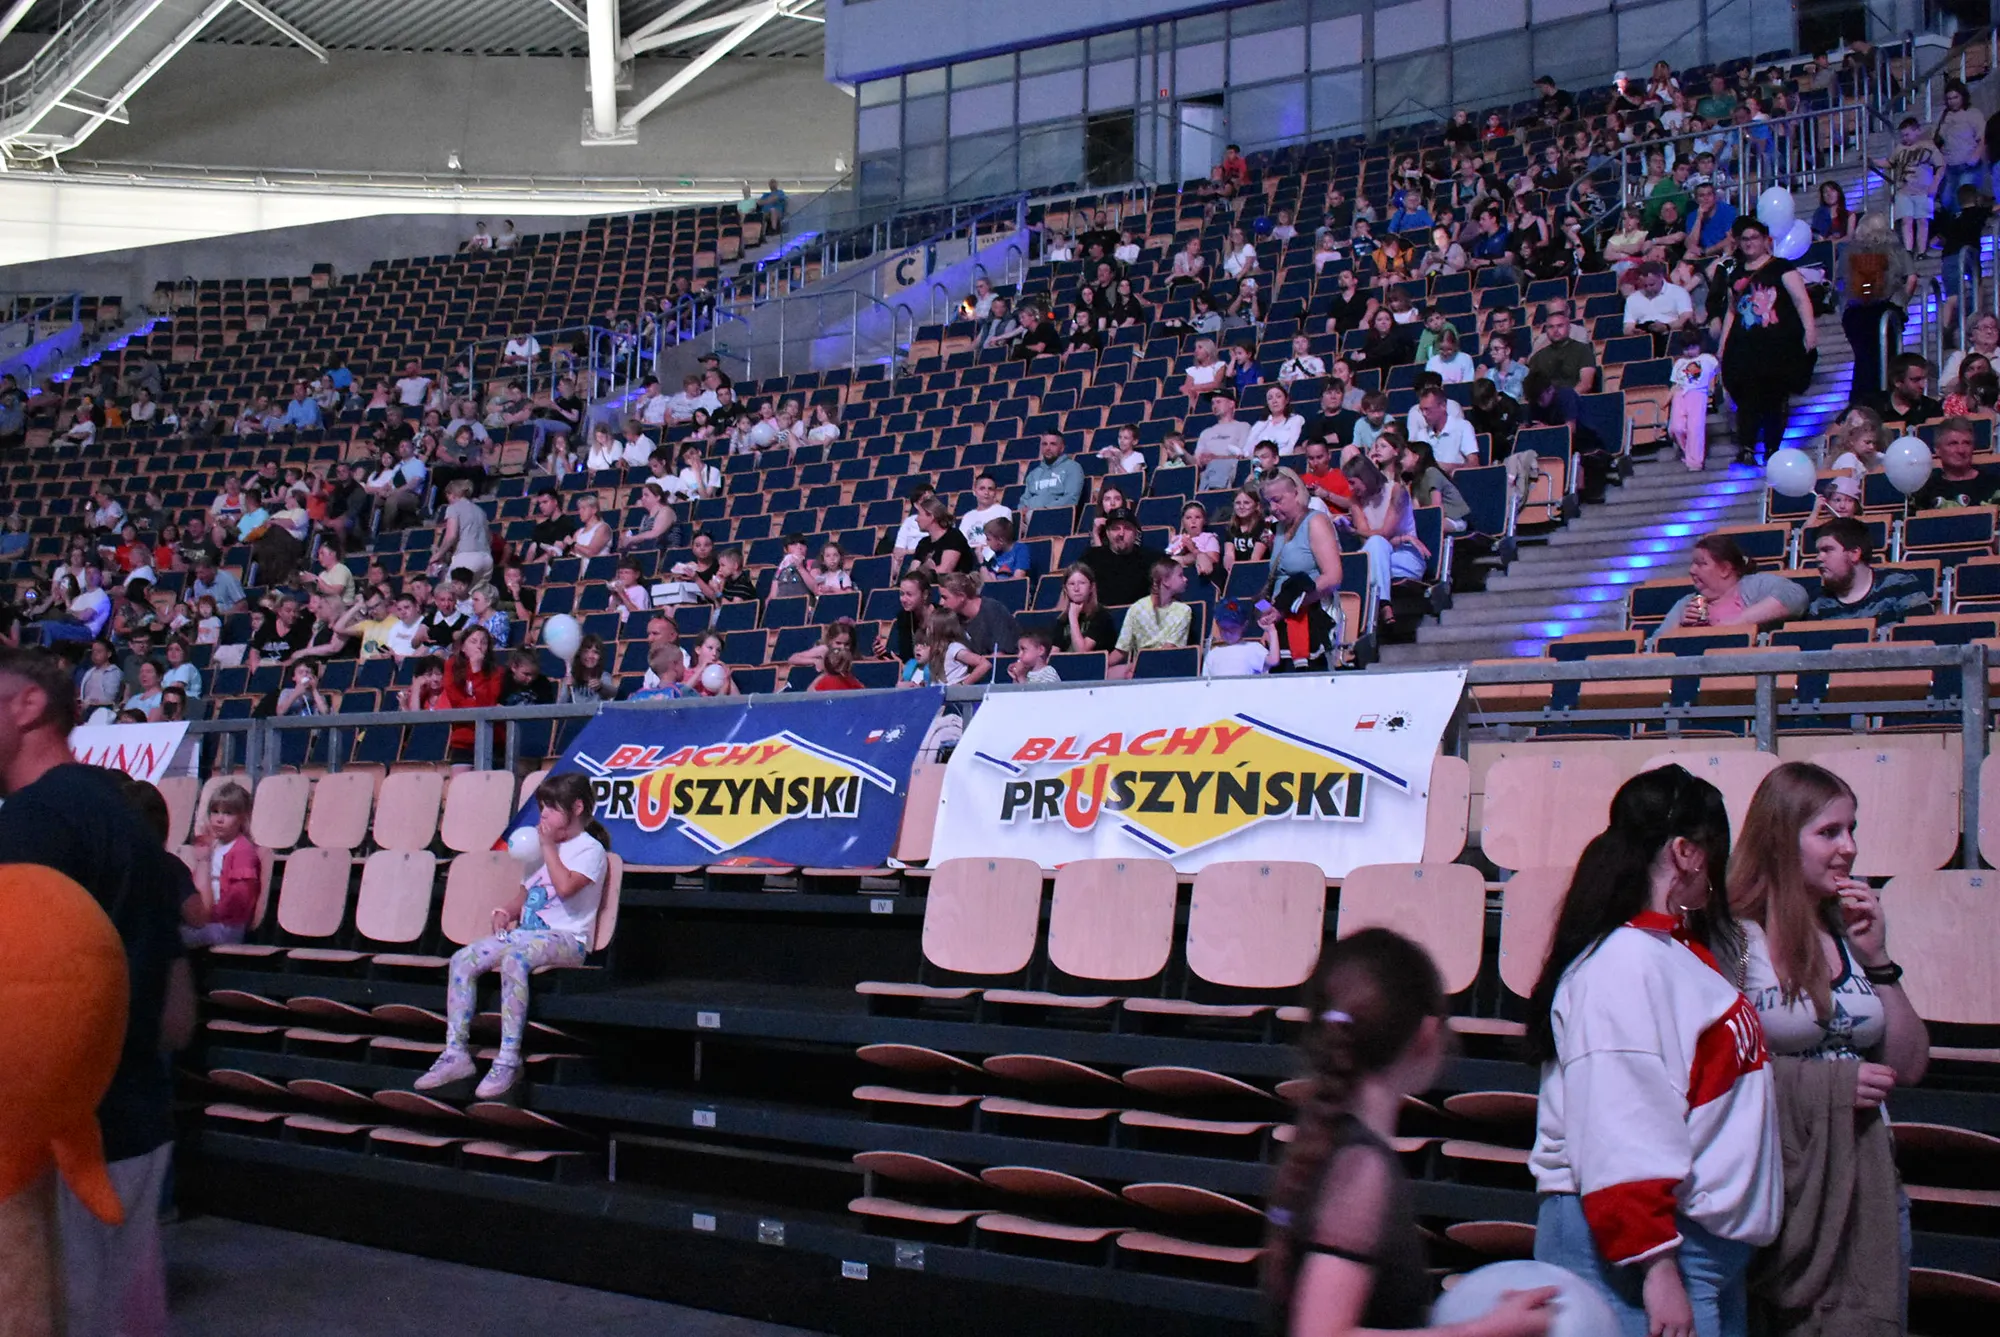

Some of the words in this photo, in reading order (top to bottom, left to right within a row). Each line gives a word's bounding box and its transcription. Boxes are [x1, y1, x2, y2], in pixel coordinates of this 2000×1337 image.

[895, 257, 916, 287] C
[604, 744, 792, 767] BLACHY
[1011, 726, 1254, 762] BLACHY
[592, 770, 860, 828] PRUSZYŃSKI
[1000, 761, 1364, 829] PRUSZYŃSKI
